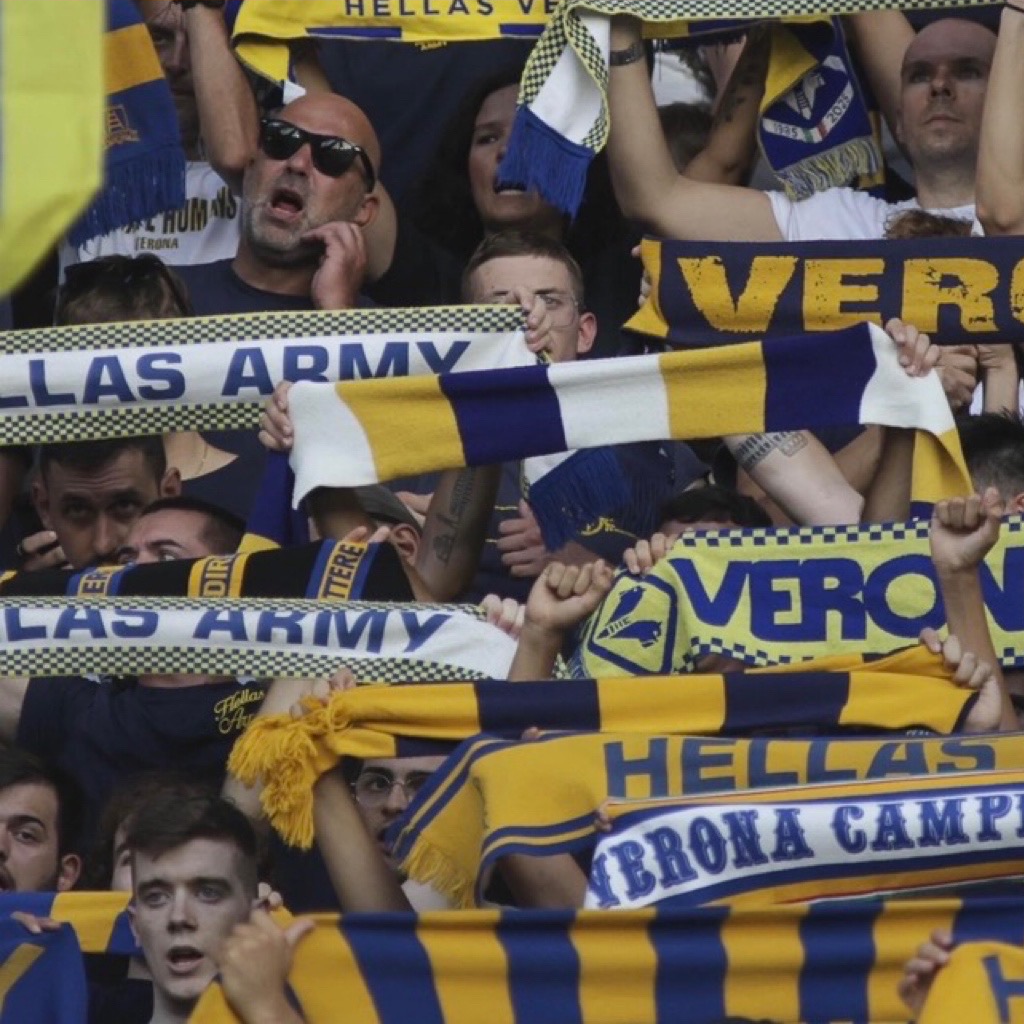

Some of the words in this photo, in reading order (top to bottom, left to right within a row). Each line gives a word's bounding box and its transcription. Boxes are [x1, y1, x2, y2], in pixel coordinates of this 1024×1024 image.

[345, 0, 495, 17] HELLAS
[192, 609, 452, 655] ARMY
[603, 737, 999, 799] HELLAS
[588, 808, 813, 908] VERONA
